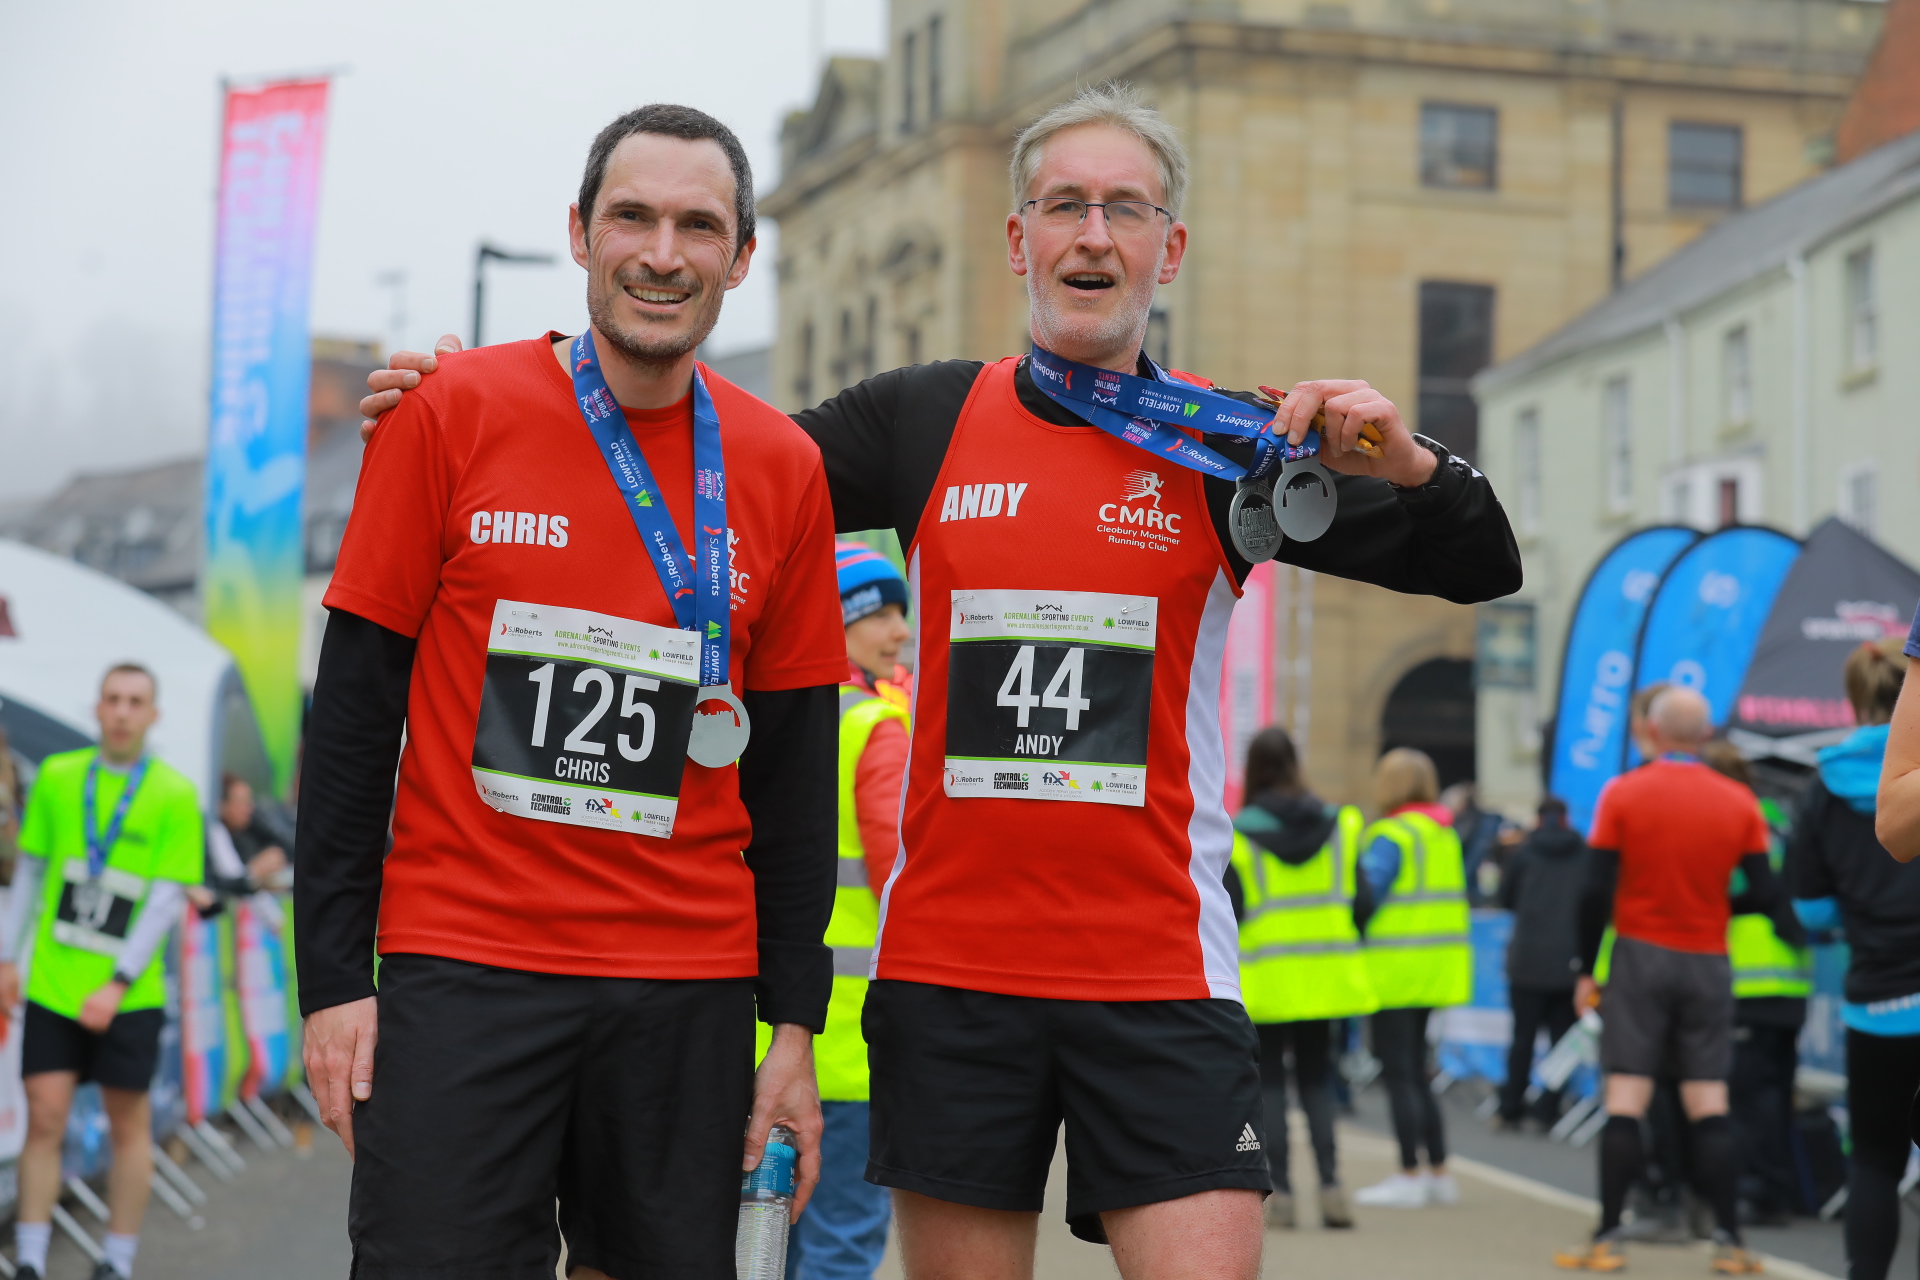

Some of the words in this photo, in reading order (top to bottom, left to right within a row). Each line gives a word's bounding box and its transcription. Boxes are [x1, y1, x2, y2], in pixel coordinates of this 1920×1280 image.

[1033, 357, 1064, 383] SJRoberts
[1098, 371, 1120, 383] EVENTS
[1095, 379, 1121, 392] SPORTING
[1142, 388, 1161, 398] FRAMES
[592, 389, 610, 418] SPORTING
[600, 387, 616, 412] EVENTS
[1138, 396, 1180, 413] LOWFIELD
[1163, 393, 1182, 403] TIMBER
[1216, 413, 1263, 430] SJRoberts
[1122, 430, 1144, 444] EVENTS
[1125, 422, 1152, 440] SPORTING
[620, 438, 634, 461] FRAMES
[1179, 445, 1225, 470] SJRoberts
[611, 442, 638, 488] LOWFIELD
[631, 462, 645, 485] TIMBER
[940, 483, 1028, 523] ANDY
[1099, 503, 1181, 533] CMRC
[470, 511, 569, 548] CHRIS
[1096, 524, 1137, 537] Cleobury
[1140, 529, 1180, 545] Mortimer
[1108, 535, 1145, 549] Running
[1148, 541, 1168, 552] Club
[654, 530, 683, 588] SJRoberts
[710, 537, 720, 596] SJRoberts
[1004, 612, 1040, 620] ADRENALINE
[1041, 613, 1069, 621] SPORTING
[1071, 614, 1094, 622] EVENTS
[1118, 619, 1149, 627] LOWFIELD
[508, 626, 542, 637] SJRoberts
[554, 630, 592, 642] ADRENALINE
[592, 636, 618, 648] SPORTING
[620, 643, 641, 652] EVENTS
[662, 651, 693, 661] LOWFIELD
[997, 645, 1090, 731] 44
[528, 662, 662, 762] 125
[1014, 734, 1063, 755] ANDY
[555, 757, 611, 783] CHRIS
[994, 772, 1021, 781] CONTROL
[994, 781, 1029, 790] TECHNIQUES
[1106, 782, 1137, 790] LOWFIELD
[532, 793, 562, 805] CONTROL
[530, 802, 571, 815] TECHNIQUES
[644, 812, 670, 822] LOWFIELD
[1236, 1140, 1260, 1152] adidas
